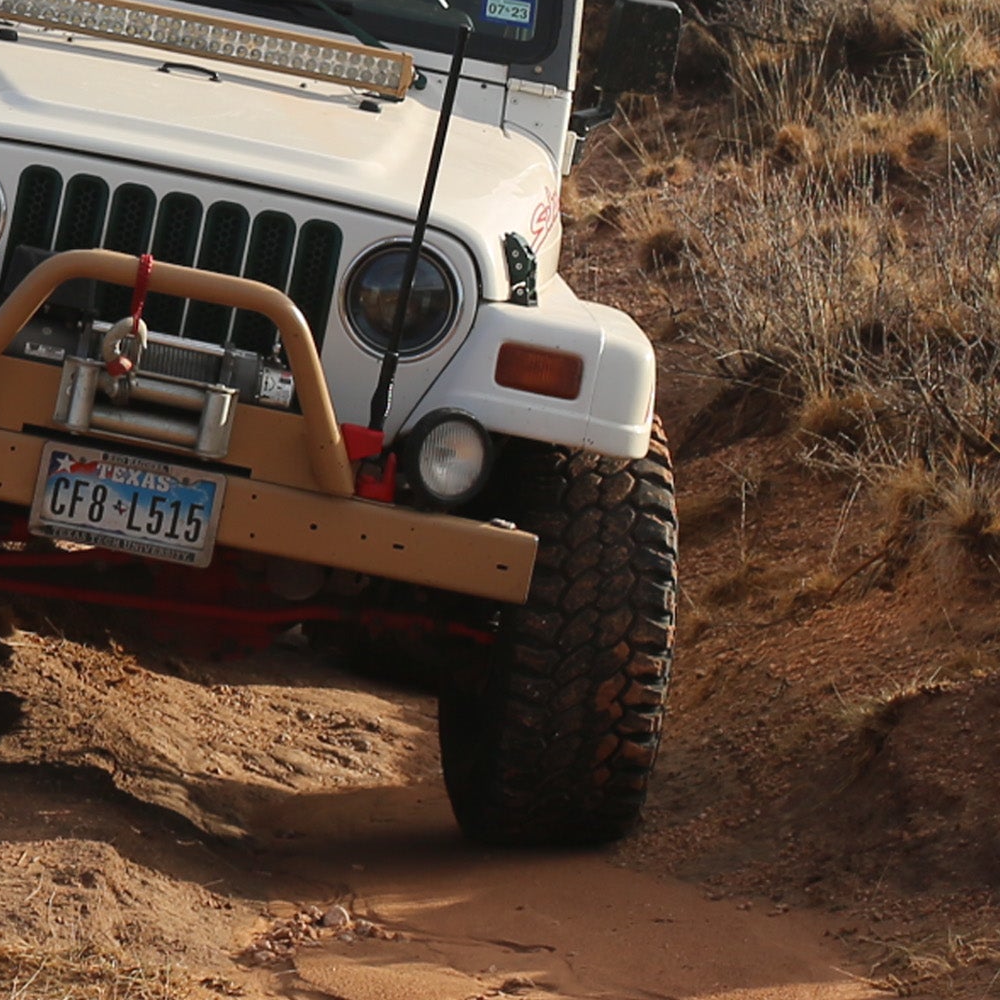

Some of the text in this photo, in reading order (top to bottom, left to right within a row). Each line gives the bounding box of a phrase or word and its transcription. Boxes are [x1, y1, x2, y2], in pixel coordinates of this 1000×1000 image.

[97, 463, 173, 493] TEXAS
[50, 476, 205, 543] CF8 L515
